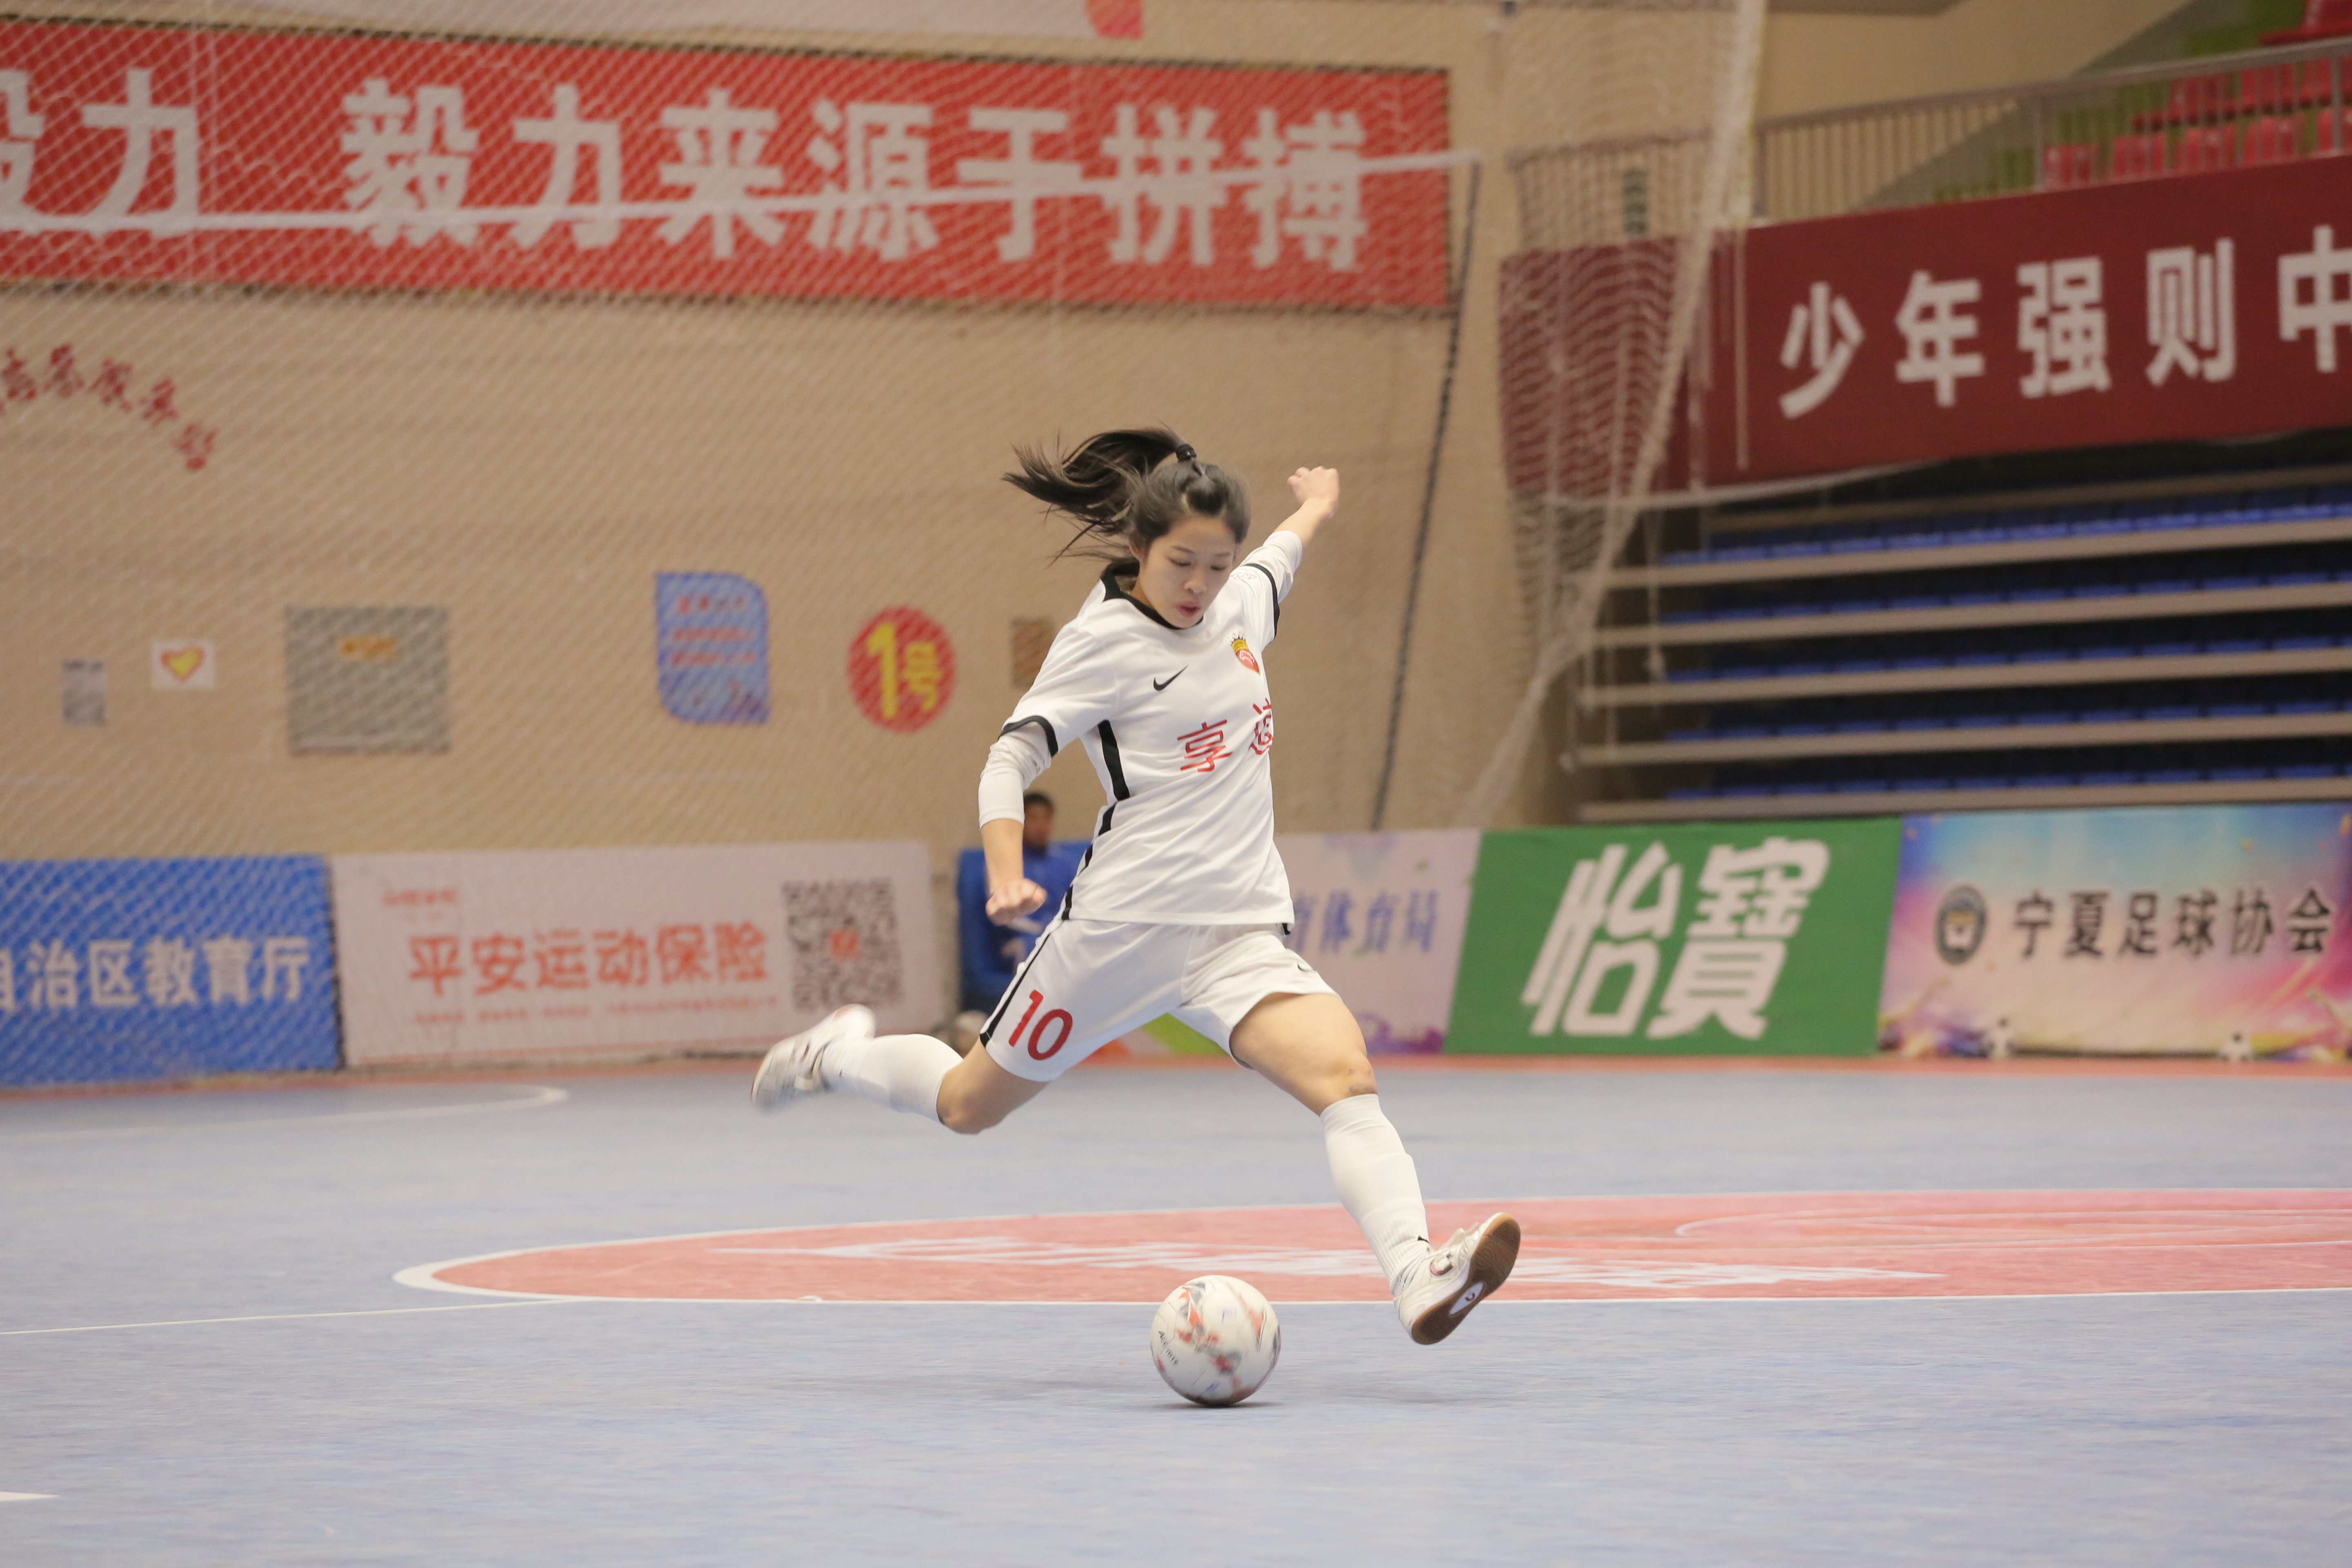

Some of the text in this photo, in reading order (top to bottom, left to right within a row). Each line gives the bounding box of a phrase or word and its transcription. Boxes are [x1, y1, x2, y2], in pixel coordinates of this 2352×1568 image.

[340, 78, 1368, 271] 毅力来源于拼搏
[1779, 225, 2352, 419] 少年强则中
[867, 623, 941, 719] 1号
[410, 921, 767, 996] 平安运动保险
[2013, 885, 2333, 959] 宁夏足球协会
[1009, 989, 1073, 1060] 10
